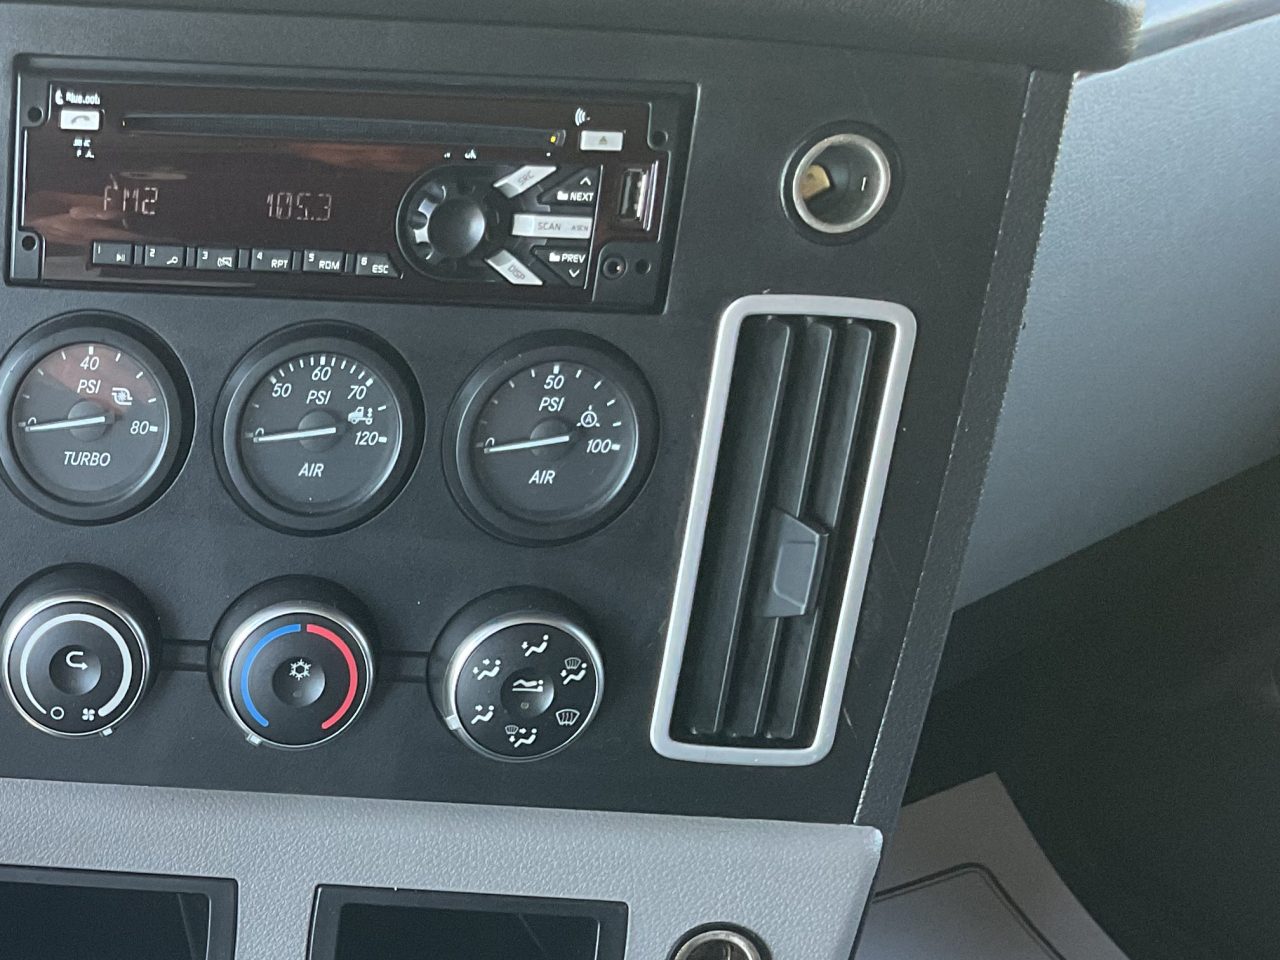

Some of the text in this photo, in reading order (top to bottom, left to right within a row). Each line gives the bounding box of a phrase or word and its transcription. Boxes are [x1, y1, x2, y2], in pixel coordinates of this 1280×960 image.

[519, 169, 535, 186] SRC
[103, 184, 158, 216] FM2
[569, 190, 594, 202] NEXT
[266, 191, 333, 222] 105.3
[536, 221, 562, 232] SCAN
[271, 259, 289, 269] RPT
[318, 260, 340, 271] RDM
[561, 253, 586, 264] PREV
[371, 264, 389, 274] ESC
[80, 356, 100, 371] 40
[311, 366, 332, 381] 60
[76, 379, 101, 394] PSI
[543, 375, 565, 390] 50
[271, 383, 292, 398] 50
[306, 390, 332, 405] PSI
[347, 385, 367, 400] 70
[538, 397, 565, 412] PSI
[130, 420, 150, 435] 80
[354, 431, 379, 446] 120
[586, 439, 612, 454] 100
[64, 451, 111, 467] TURBO
[298, 462, 325, 478] AIR
[528, 469, 556, 485] AIR
